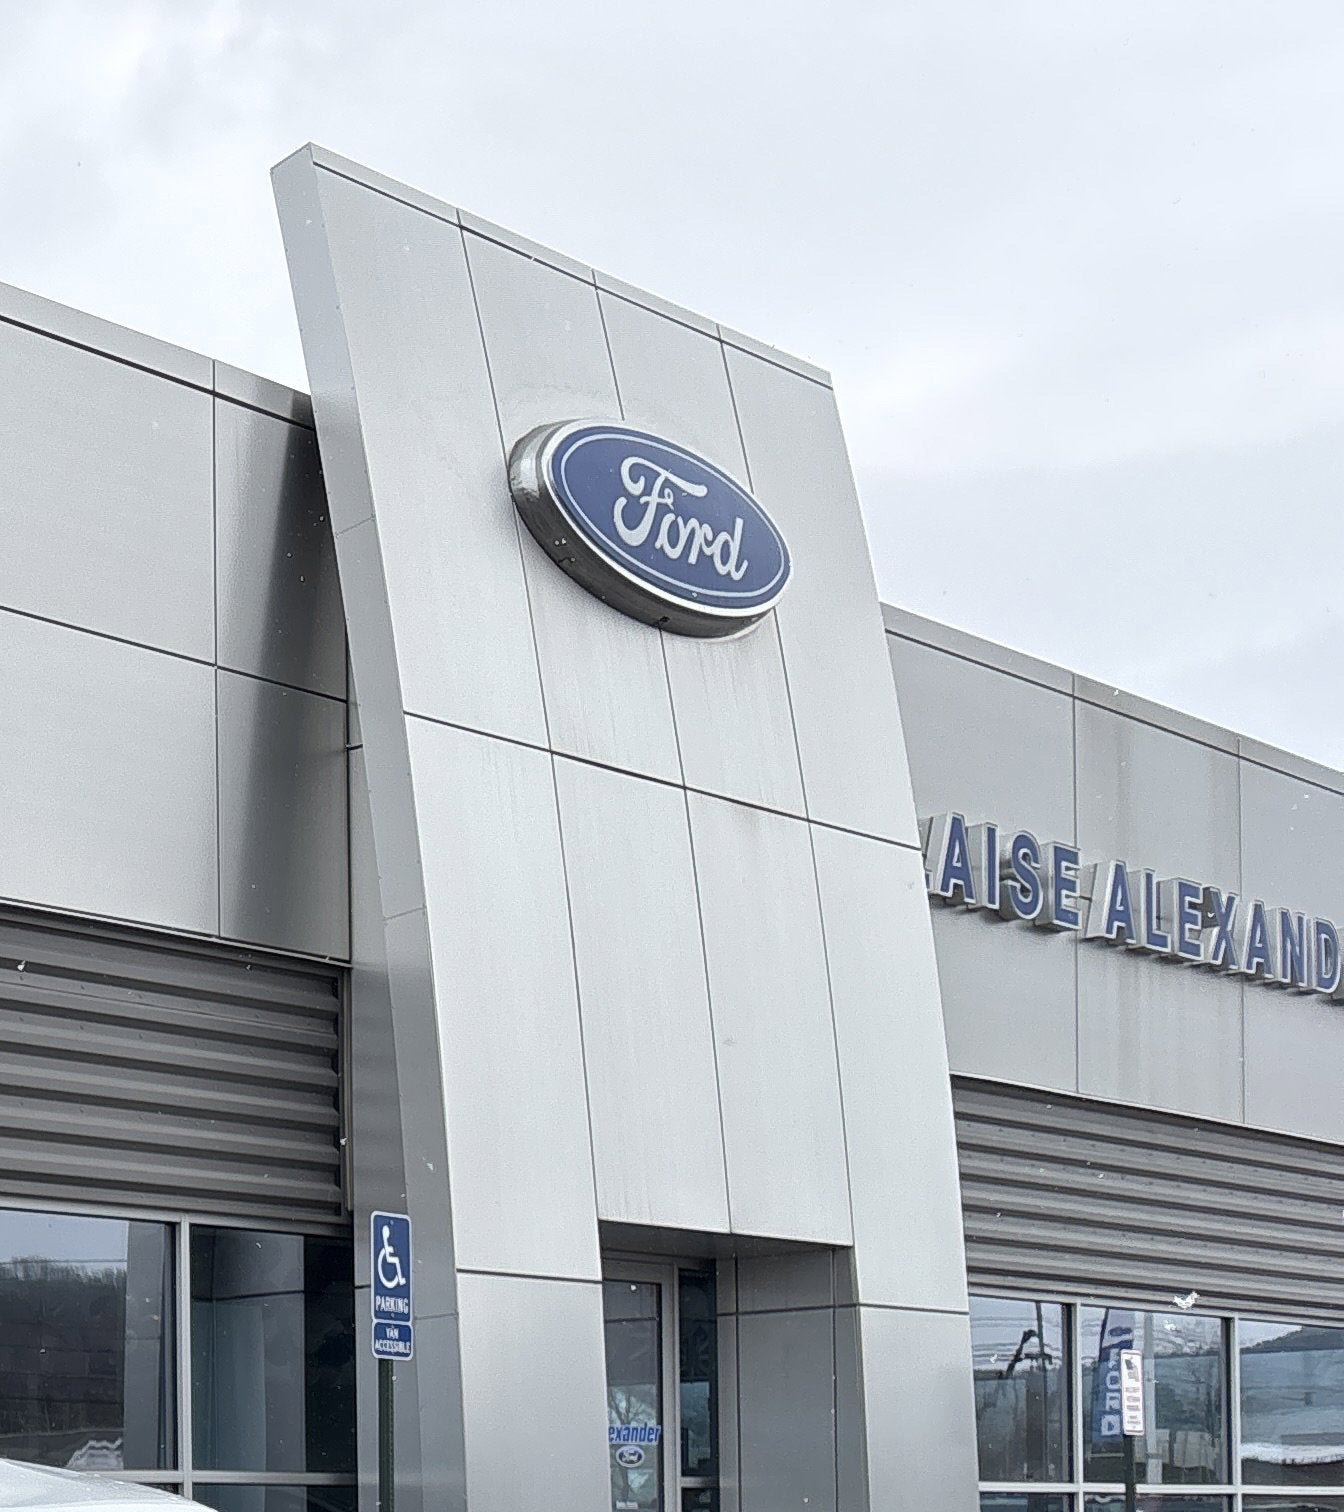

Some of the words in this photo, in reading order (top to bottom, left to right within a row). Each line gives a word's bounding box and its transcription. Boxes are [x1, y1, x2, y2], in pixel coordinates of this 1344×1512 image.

[613, 456, 748, 580] Ford
[926, 811, 1081, 930] AISE
[1094, 859, 1343, 994] ALEXAND
[375, 1295, 409, 1314] PARKING
[385, 1327, 399, 1339] VAN
[375, 1339, 410, 1353] ACCESSIBLE
